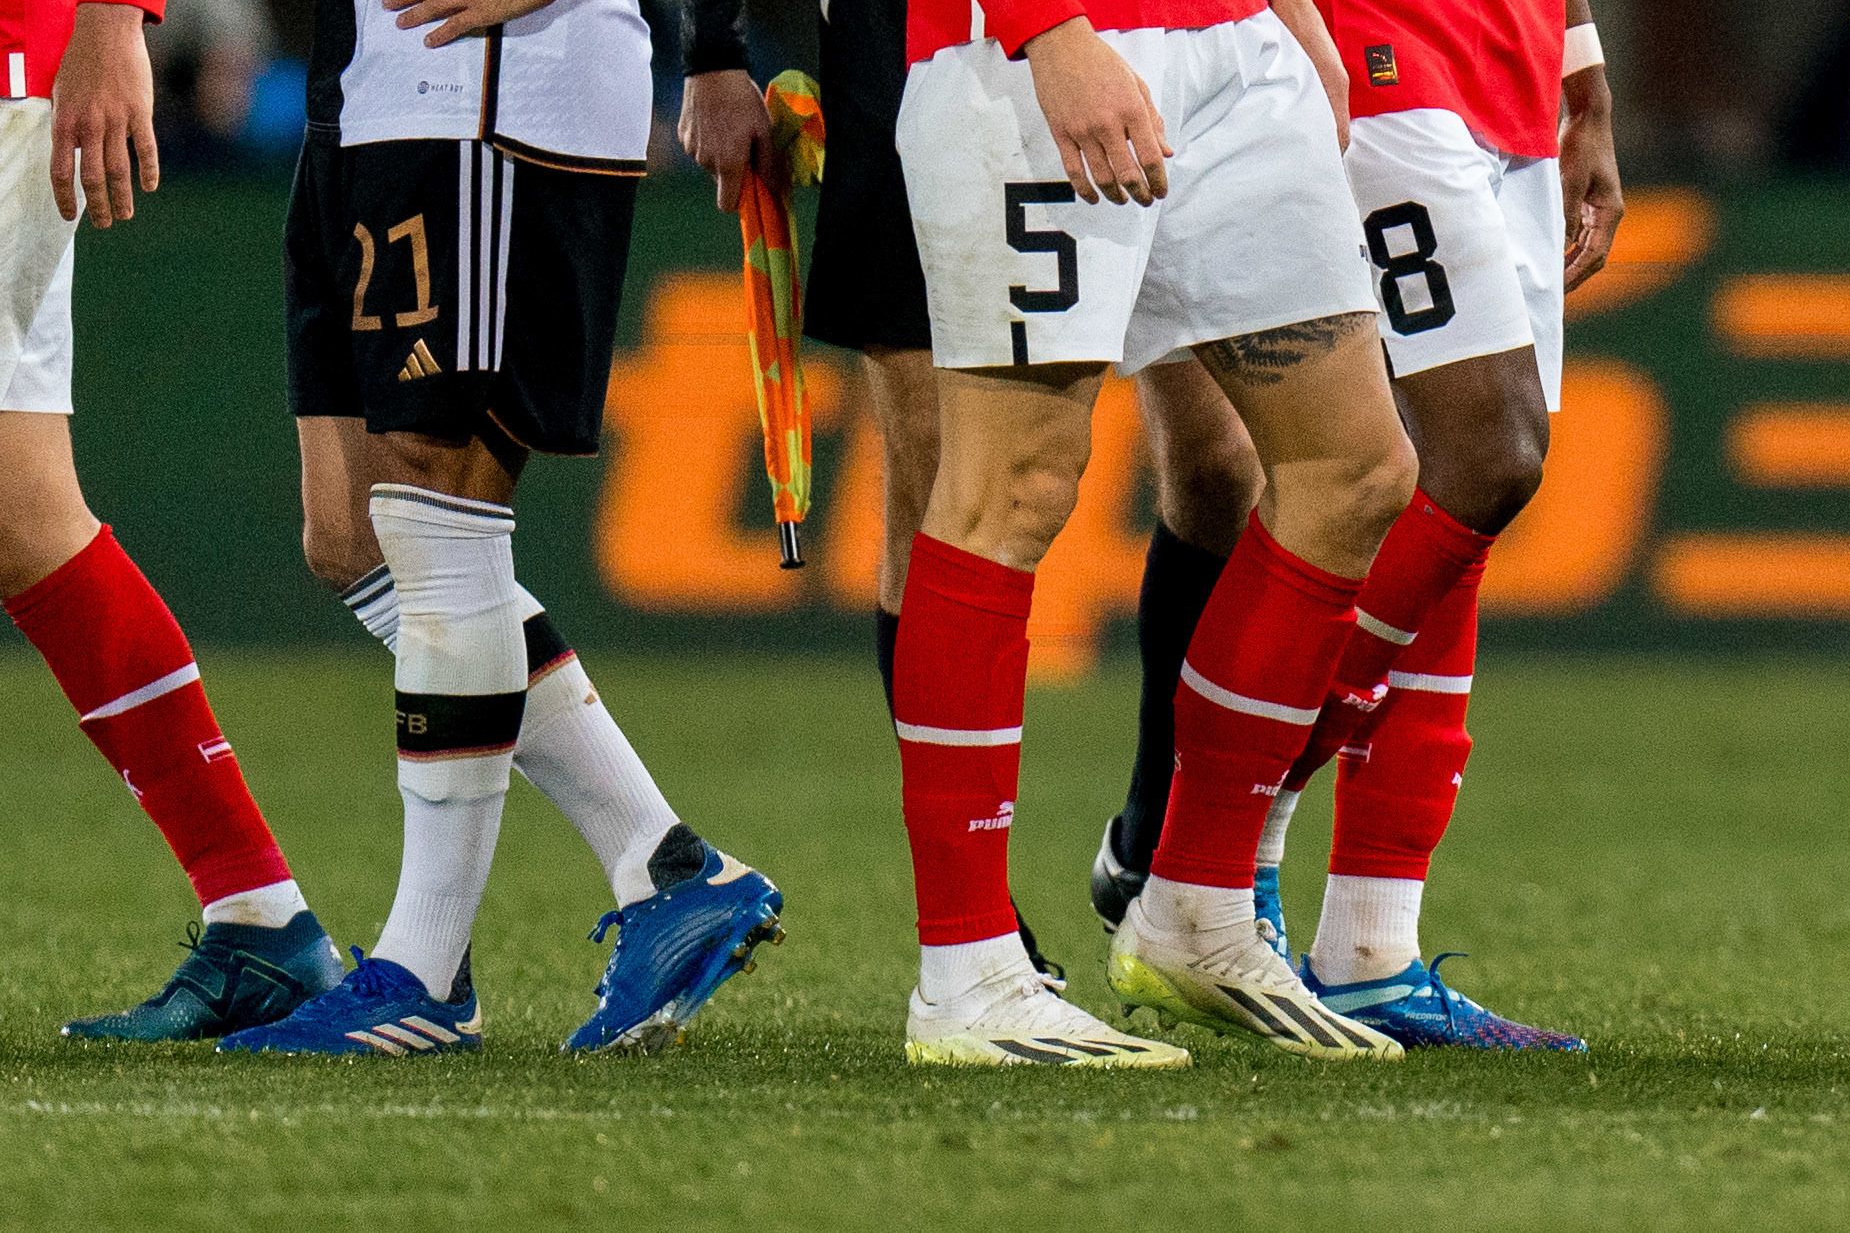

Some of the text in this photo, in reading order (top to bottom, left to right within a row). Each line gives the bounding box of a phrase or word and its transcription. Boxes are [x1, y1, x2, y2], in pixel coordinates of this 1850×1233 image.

[351, 212, 440, 331] 21
[1004, 181, 1079, 313] 5
[1363, 200, 1456, 336] 8
[395, 709, 428, 735] FB
[967, 816, 1013, 833] PUM
